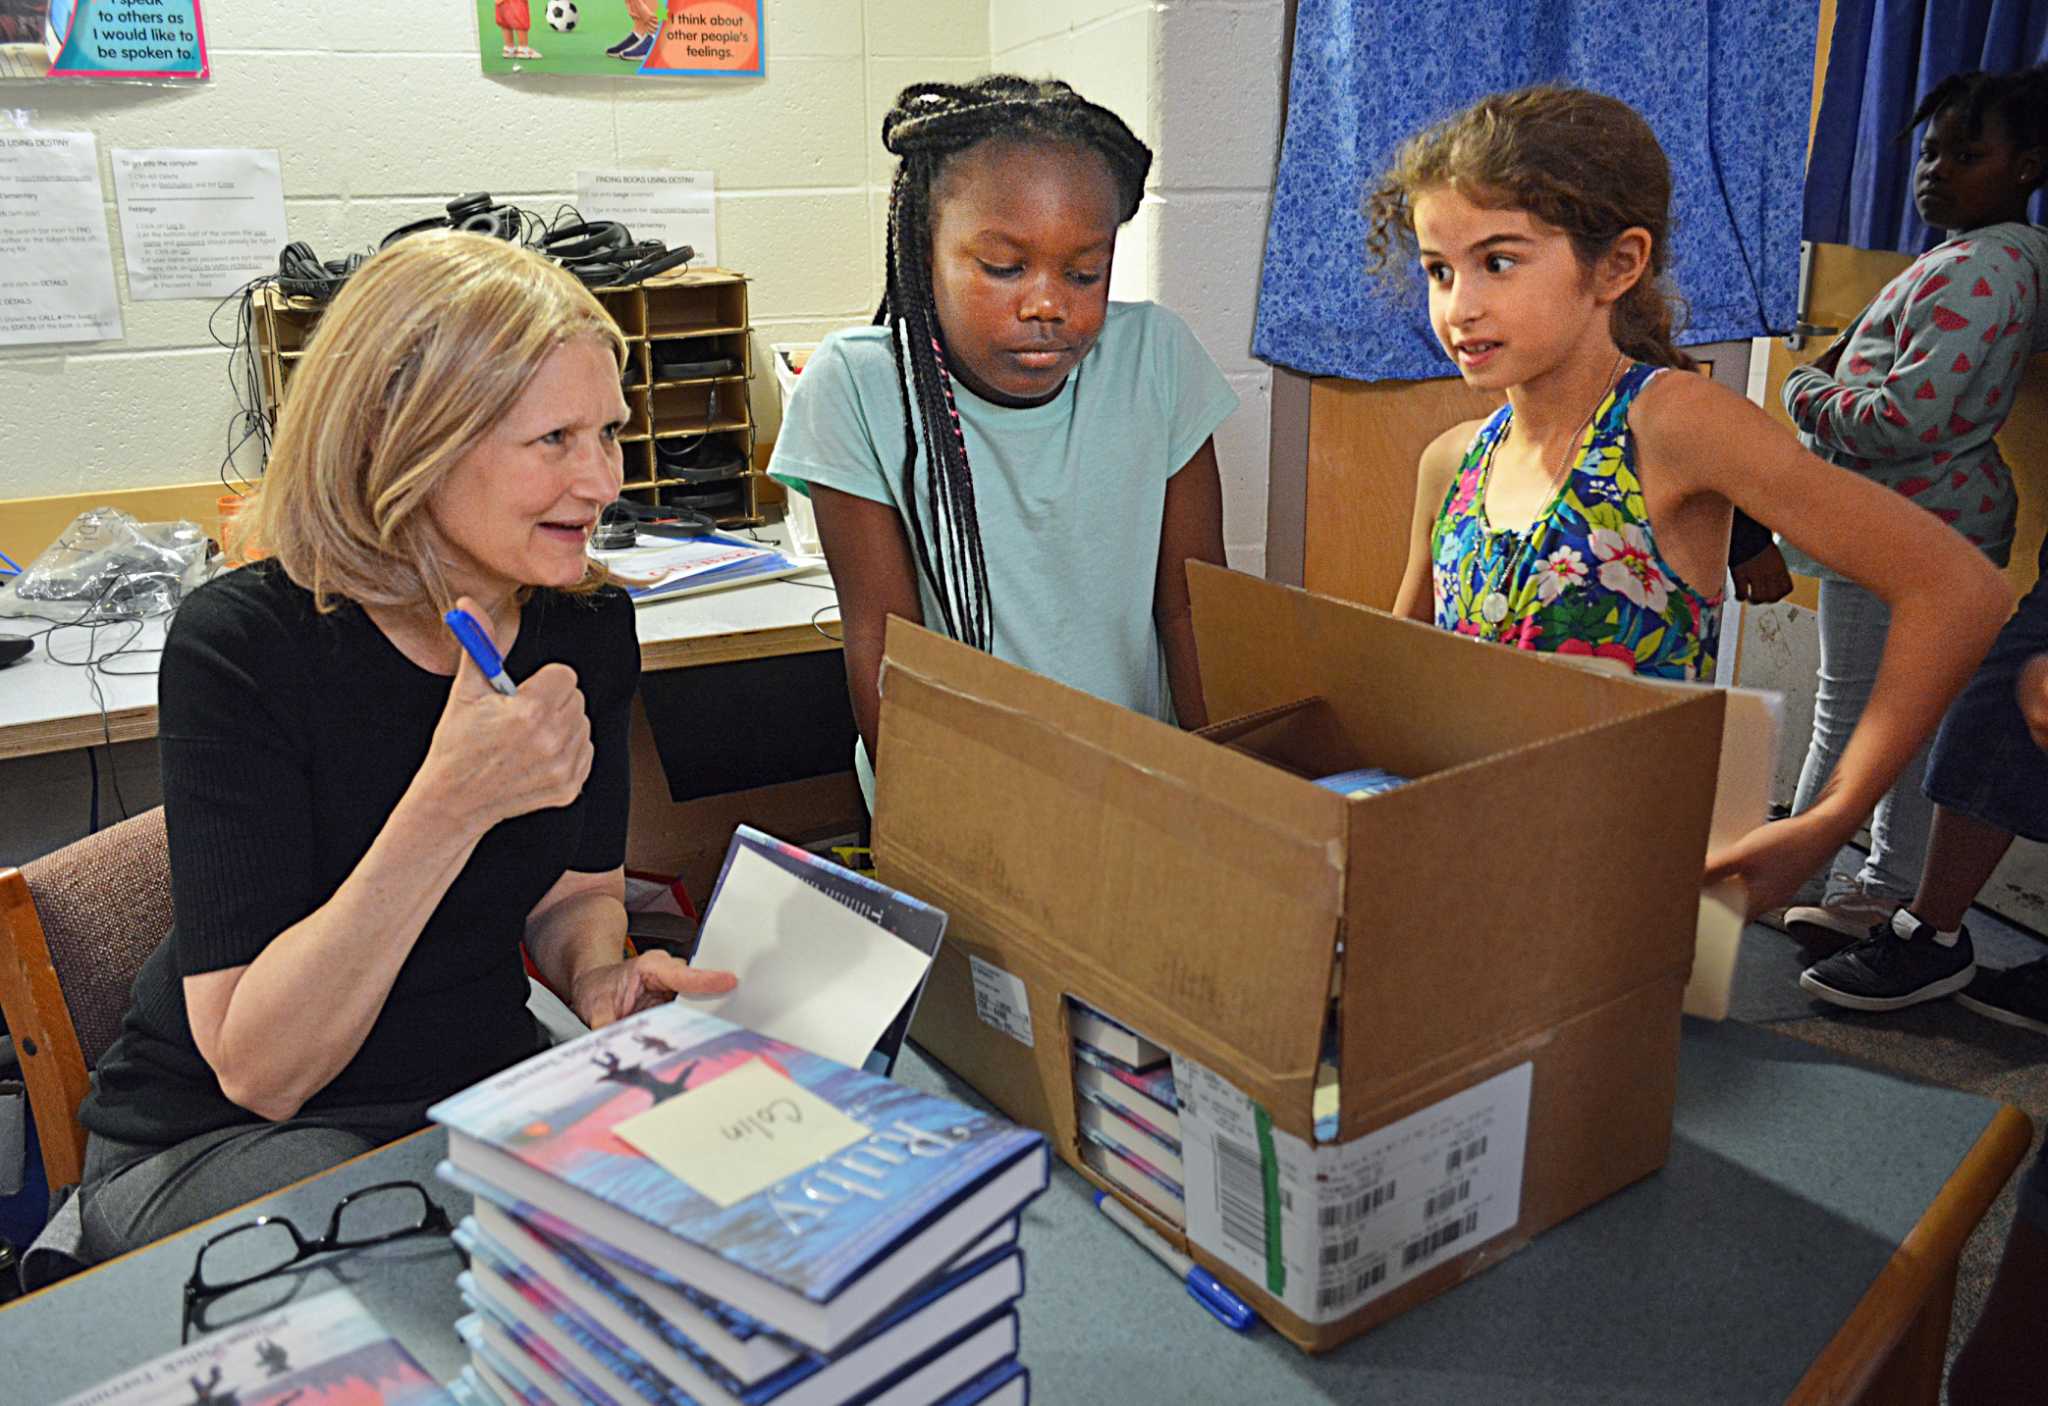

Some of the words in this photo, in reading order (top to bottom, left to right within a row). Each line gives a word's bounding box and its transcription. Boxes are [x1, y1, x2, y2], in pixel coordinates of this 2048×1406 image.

[99, 10, 113, 22] to
[118, 10, 163, 23] others
[168, 14, 184, 24] as
[671, 14, 675, 24] I
[678, 13, 706, 25] think
[710, 14, 743, 26] about
[93, 28, 98, 40] I
[102, 28, 147, 41] would
[151, 29, 176, 41] like
[180, 30, 193, 42] to
[666, 29, 697, 41] other
[701, 31, 749, 43] people's
[97, 46, 117, 58] be
[121, 46, 173, 61] spoken
[177, 47, 195, 60] to.
[687, 45, 735, 60] feelings.
[623, 176, 646, 184] BOOKS
[719, 1096, 804, 1142] Colin
